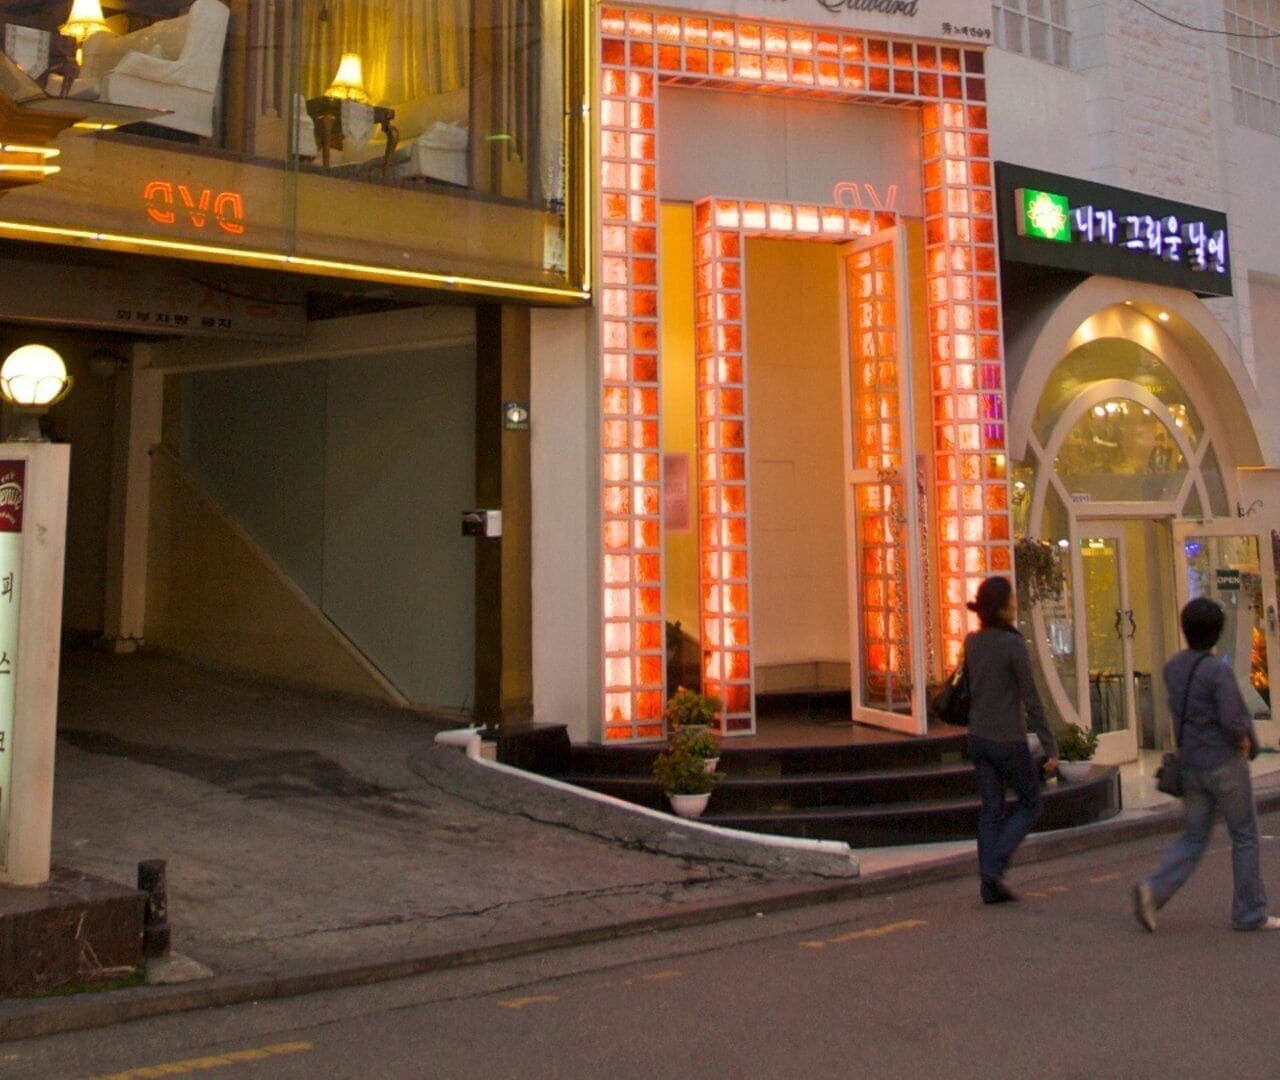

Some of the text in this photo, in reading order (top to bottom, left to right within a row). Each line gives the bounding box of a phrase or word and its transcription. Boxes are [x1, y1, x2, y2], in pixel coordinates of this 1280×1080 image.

[1075, 205, 1116, 244] 니가
[1127, 215, 1182, 261] 그리운
[1216, 575, 1240, 585] OPEN
